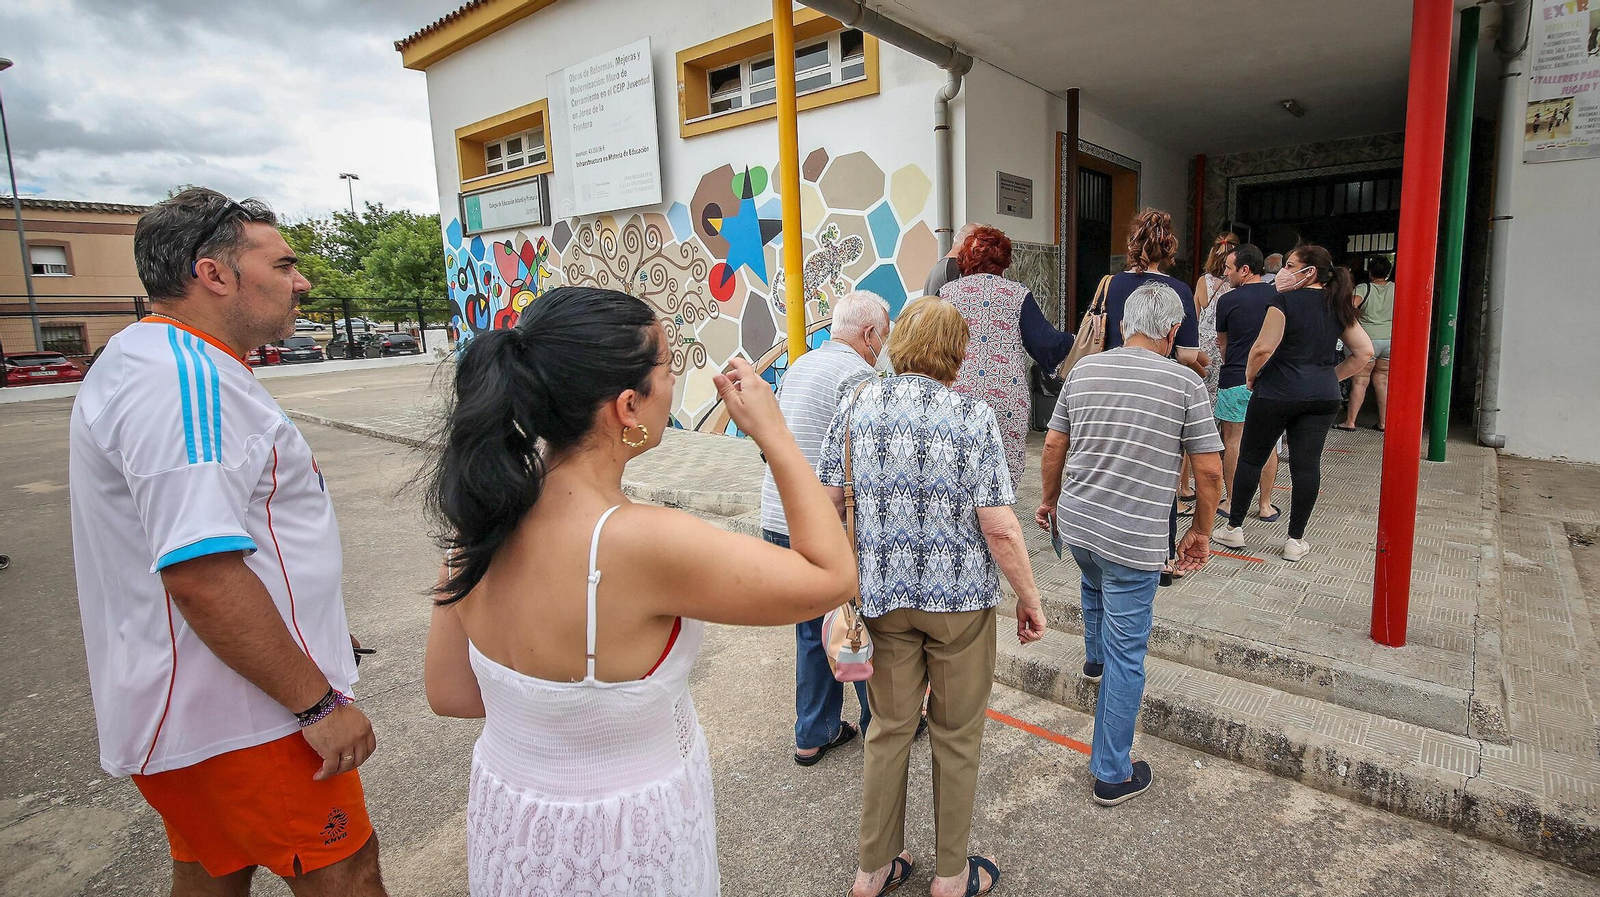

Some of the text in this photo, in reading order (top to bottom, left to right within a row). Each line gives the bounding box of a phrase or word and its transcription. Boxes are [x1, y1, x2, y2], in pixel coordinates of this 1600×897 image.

[569, 51, 640, 82] Obras de Reformas, Mejoras y
[606, 73, 620, 83] Muro
[621, 69, 627, 77] de
[571, 93, 599, 107] Cerramiento
[608, 87, 612, 96] el
[613, 82, 626, 94] CEIP
[627, 74, 650, 90] Juventud
[1560, 83, 1590, 95] JUGAR
[579, 108, 591, 118] Jerez
[592, 105, 598, 113] de
[573, 121, 593, 132] Frontera
[608, 152, 622, 160] Materia
[628, 146, 649, 156] Educación
[324, 832, 347, 846] KNVB
